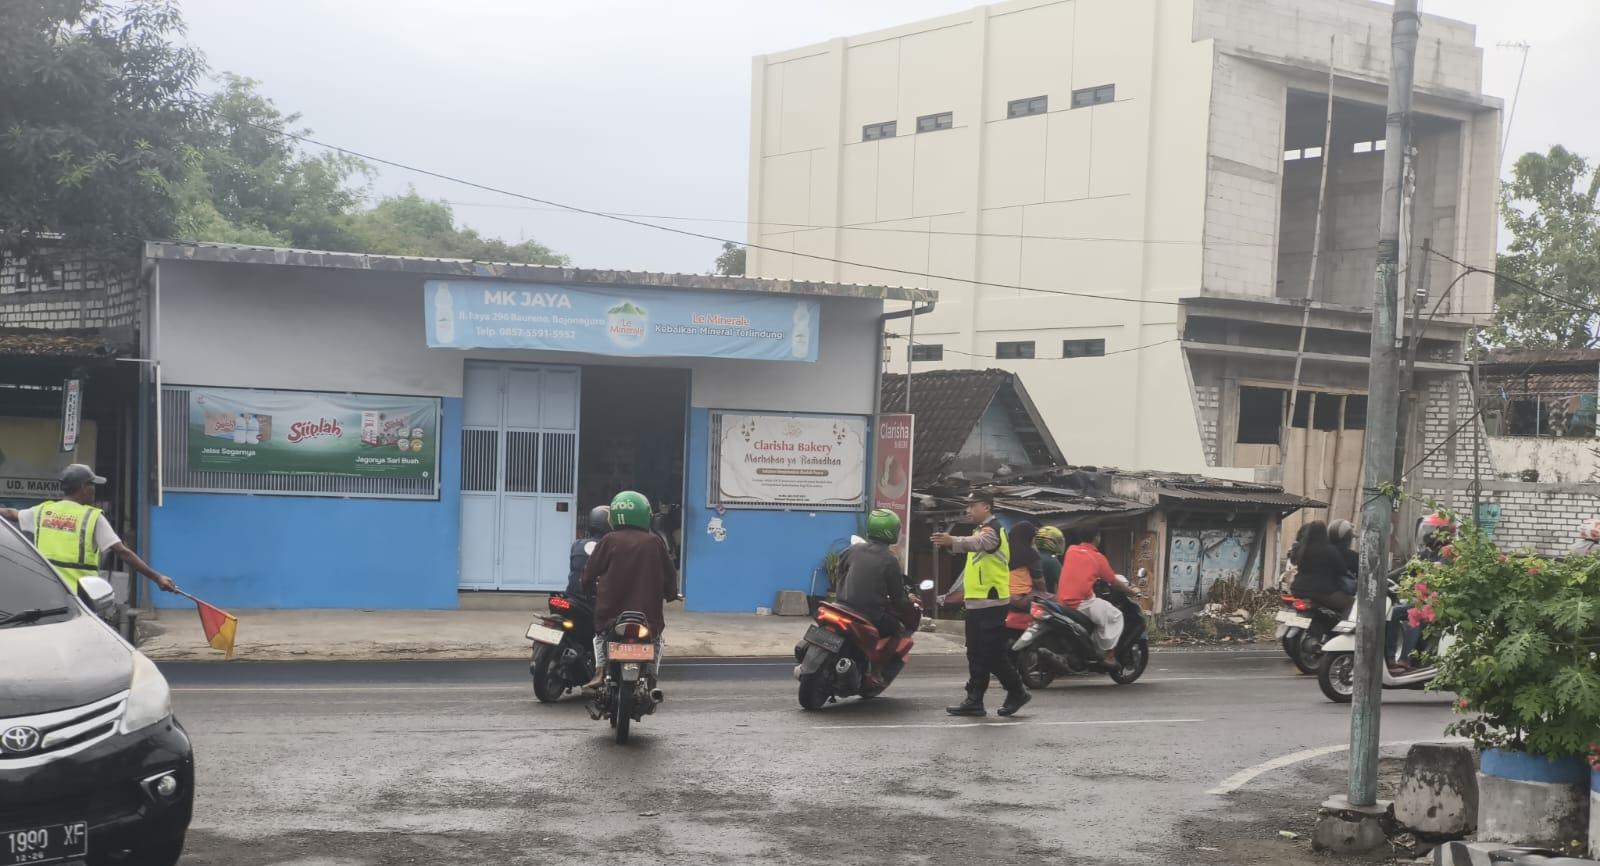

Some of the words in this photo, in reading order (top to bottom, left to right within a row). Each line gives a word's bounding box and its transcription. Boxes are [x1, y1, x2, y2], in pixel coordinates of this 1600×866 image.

[484, 290, 516, 306] MK
[520, 291, 572, 309] JAYA
[623, 319, 633, 327] Le
[692, 311, 705, 325] Le
[707, 312, 752, 327] Minerale
[655, 323, 697, 335] Kebaikan
[699, 325, 733, 338] Mineral
[287, 417, 342, 442] Siiplah
[880, 422, 909, 440] Clarisha
[201, 447, 220, 455] Jelas
[221, 448, 256, 457] Segarnya
[754, 440, 794, 452] Clarisha
[798, 441, 833, 455] Bakery
[355, 456, 385, 465] Jagonya
[800, 454, 841, 466] Ramadhan
[8, 828, 48, 853] 1990
[63, 824, 84, 846] XF
